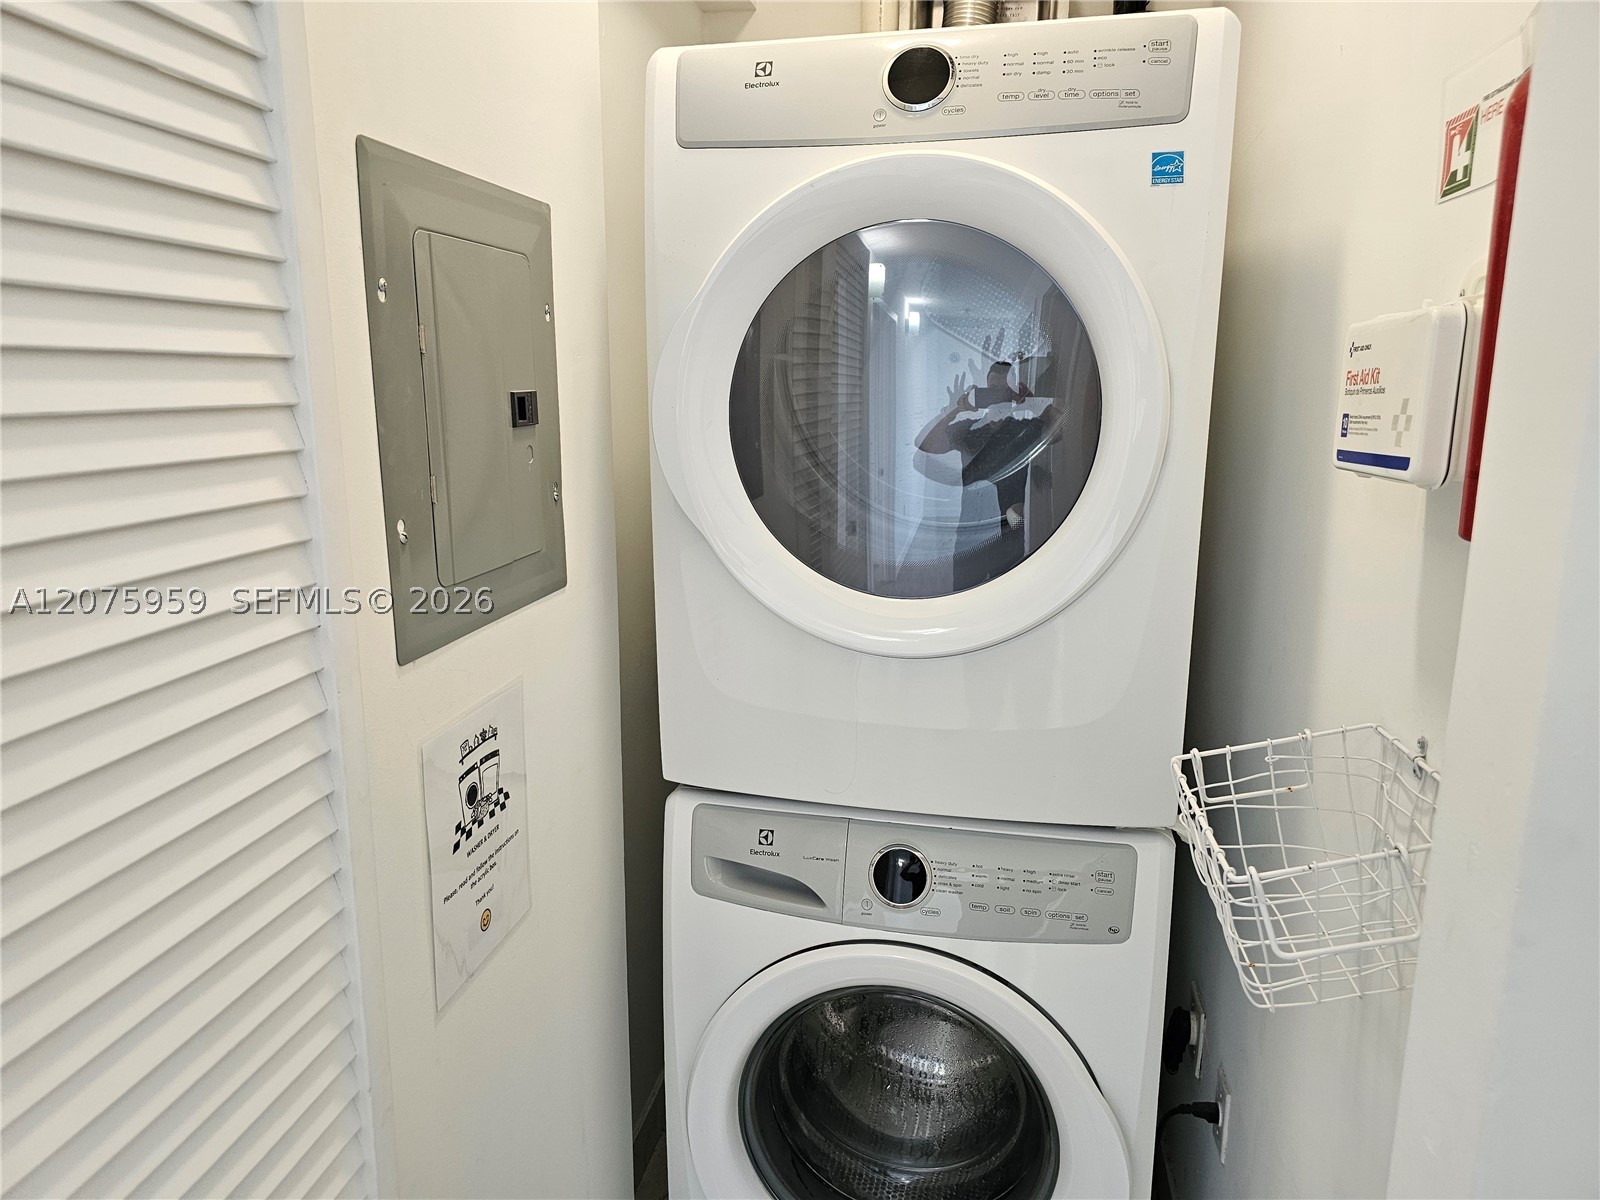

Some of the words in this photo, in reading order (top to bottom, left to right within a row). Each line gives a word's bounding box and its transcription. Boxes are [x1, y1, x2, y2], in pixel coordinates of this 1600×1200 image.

[744, 81, 780, 89] Electrolux
[1481, 97, 1505, 125] HERE
[1346, 370, 1359, 386] First
[1359, 369, 1370, 385] Aid
[1370, 367, 1381, 384] Kit
[467, 838, 483, 858] WASHER
[488, 824, 500, 839] DRYER
[458, 876, 468, 890] read
[476, 859, 488, 873] follow
[494, 834, 514, 855] instructions
[514, 829, 519, 837] on
[750, 849, 780, 858] Electrolux
[478, 868, 489, 883] acrylic
[475, 892, 486, 906] Thank
